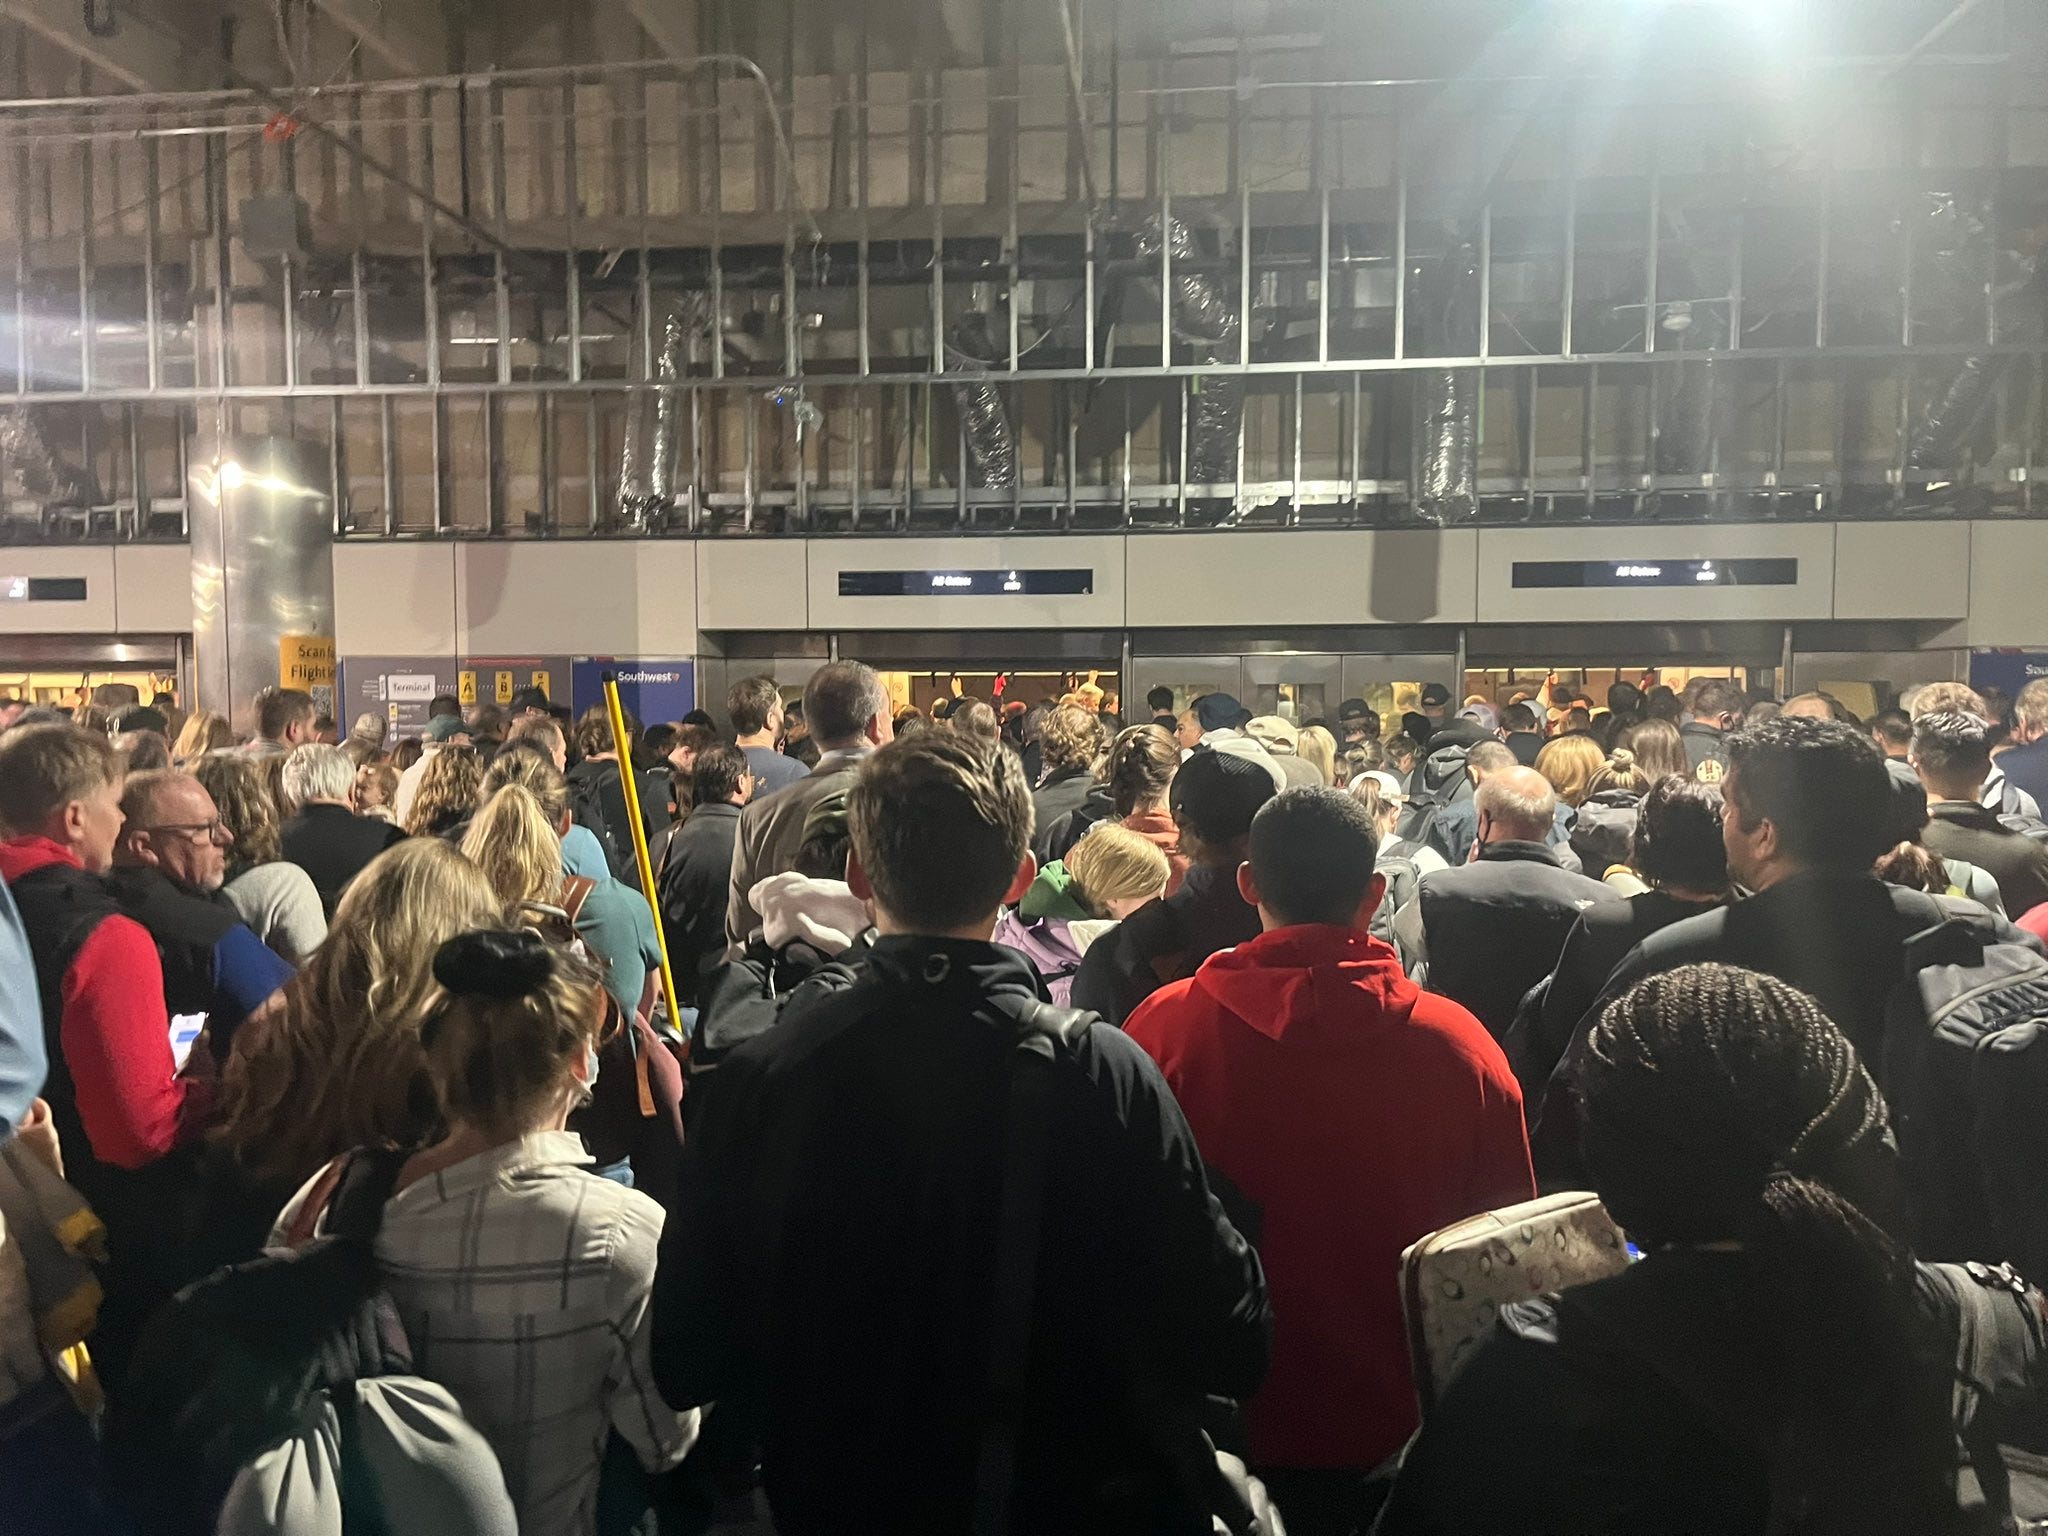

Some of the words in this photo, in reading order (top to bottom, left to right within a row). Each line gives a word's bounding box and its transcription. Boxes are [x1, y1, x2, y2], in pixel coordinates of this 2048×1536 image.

[298, 645, 326, 657] Scan
[291, 663, 327, 681] Flight
[617, 671, 672, 682] Southwest
[393, 682, 430, 692] Terminal
[464, 682, 473, 692] A
[500, 682, 508, 692] B
